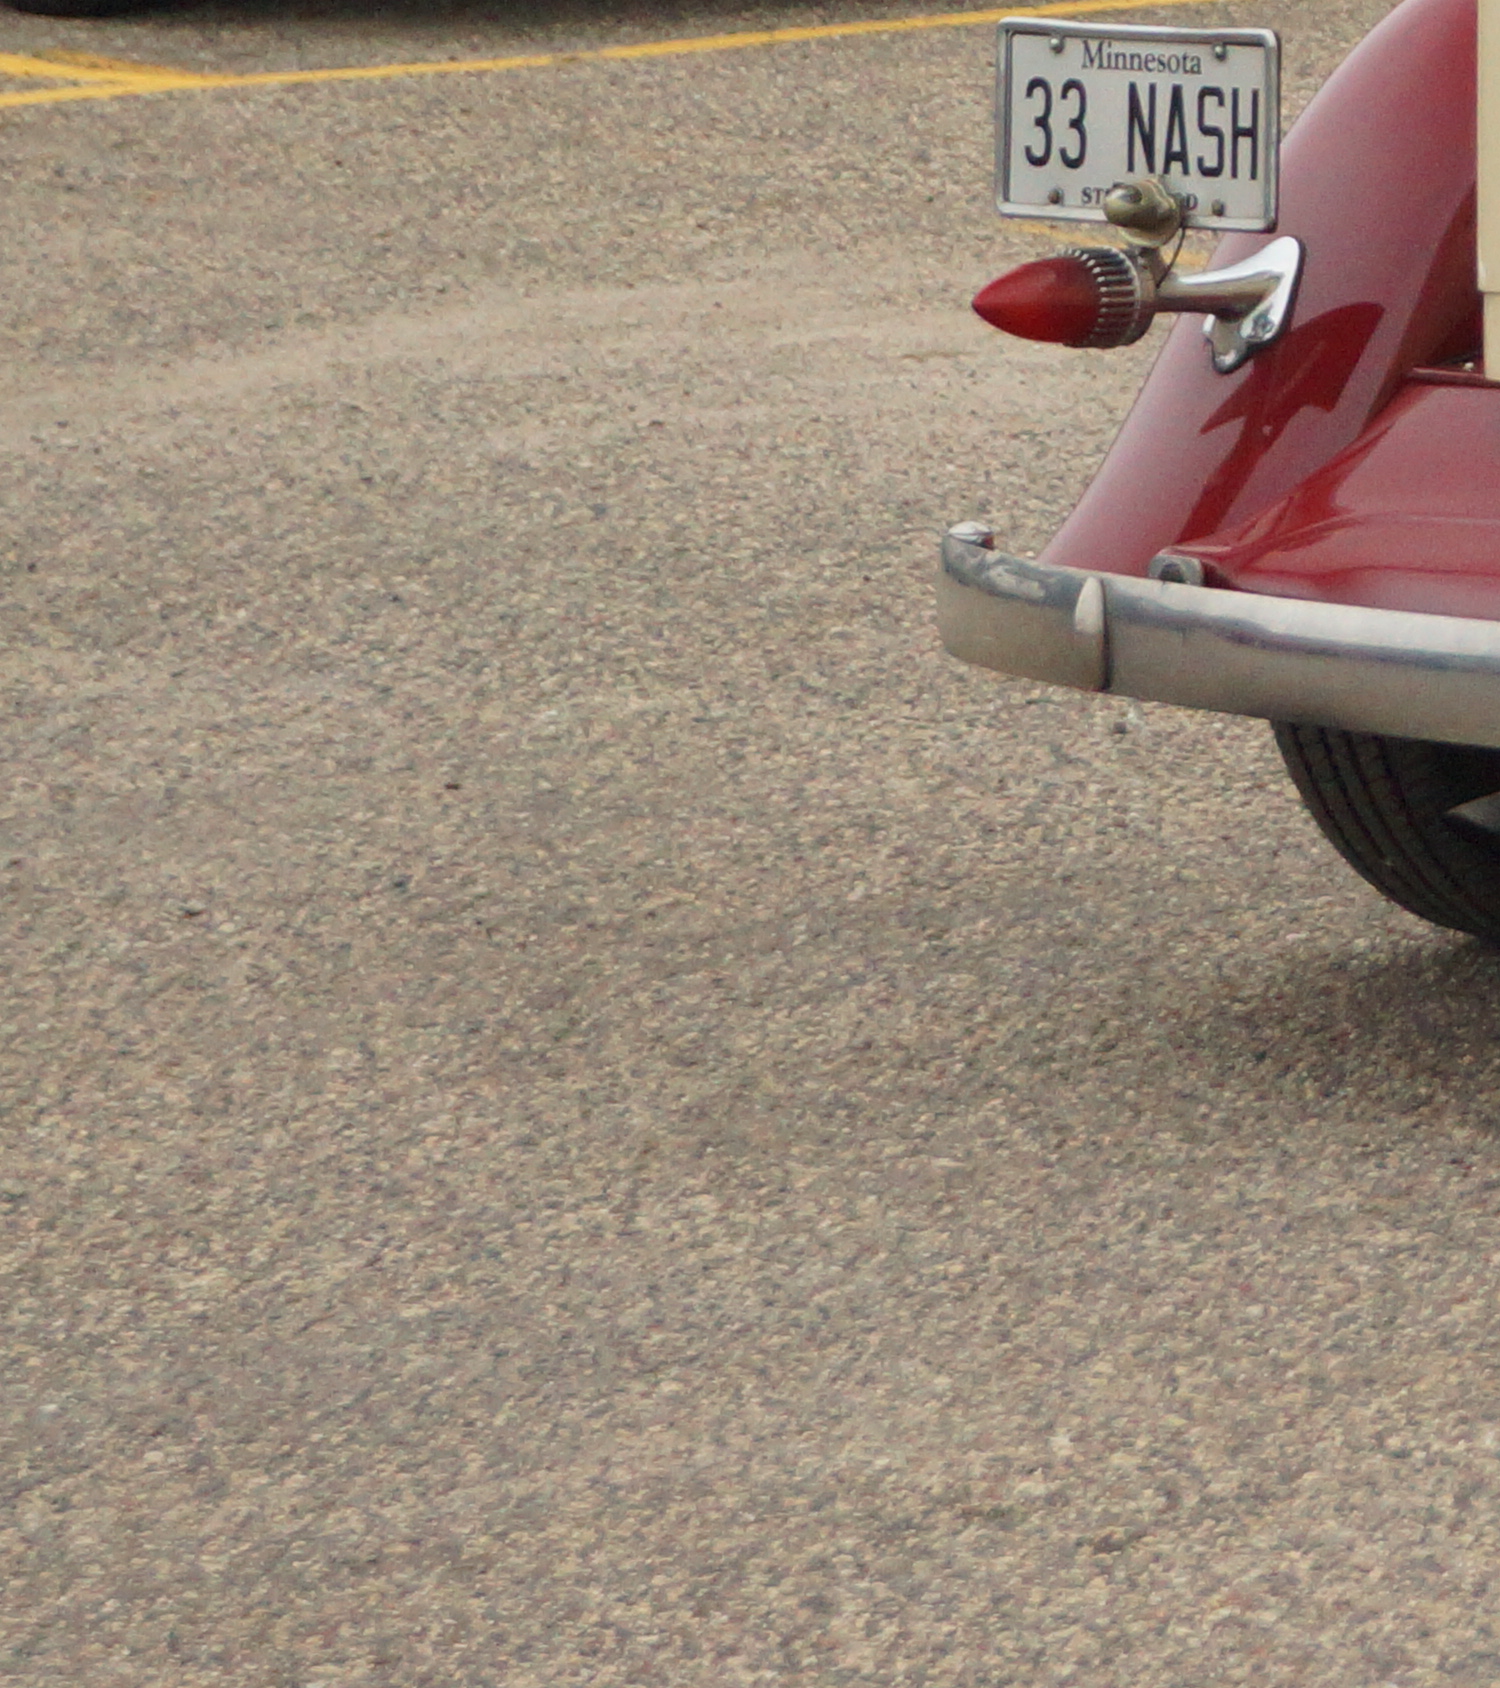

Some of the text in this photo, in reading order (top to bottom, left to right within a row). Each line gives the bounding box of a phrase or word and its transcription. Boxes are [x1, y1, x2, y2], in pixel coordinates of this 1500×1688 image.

[1081, 39, 1203, 75] Minnesota
[1024, 76, 1260, 180] 33 NASH
